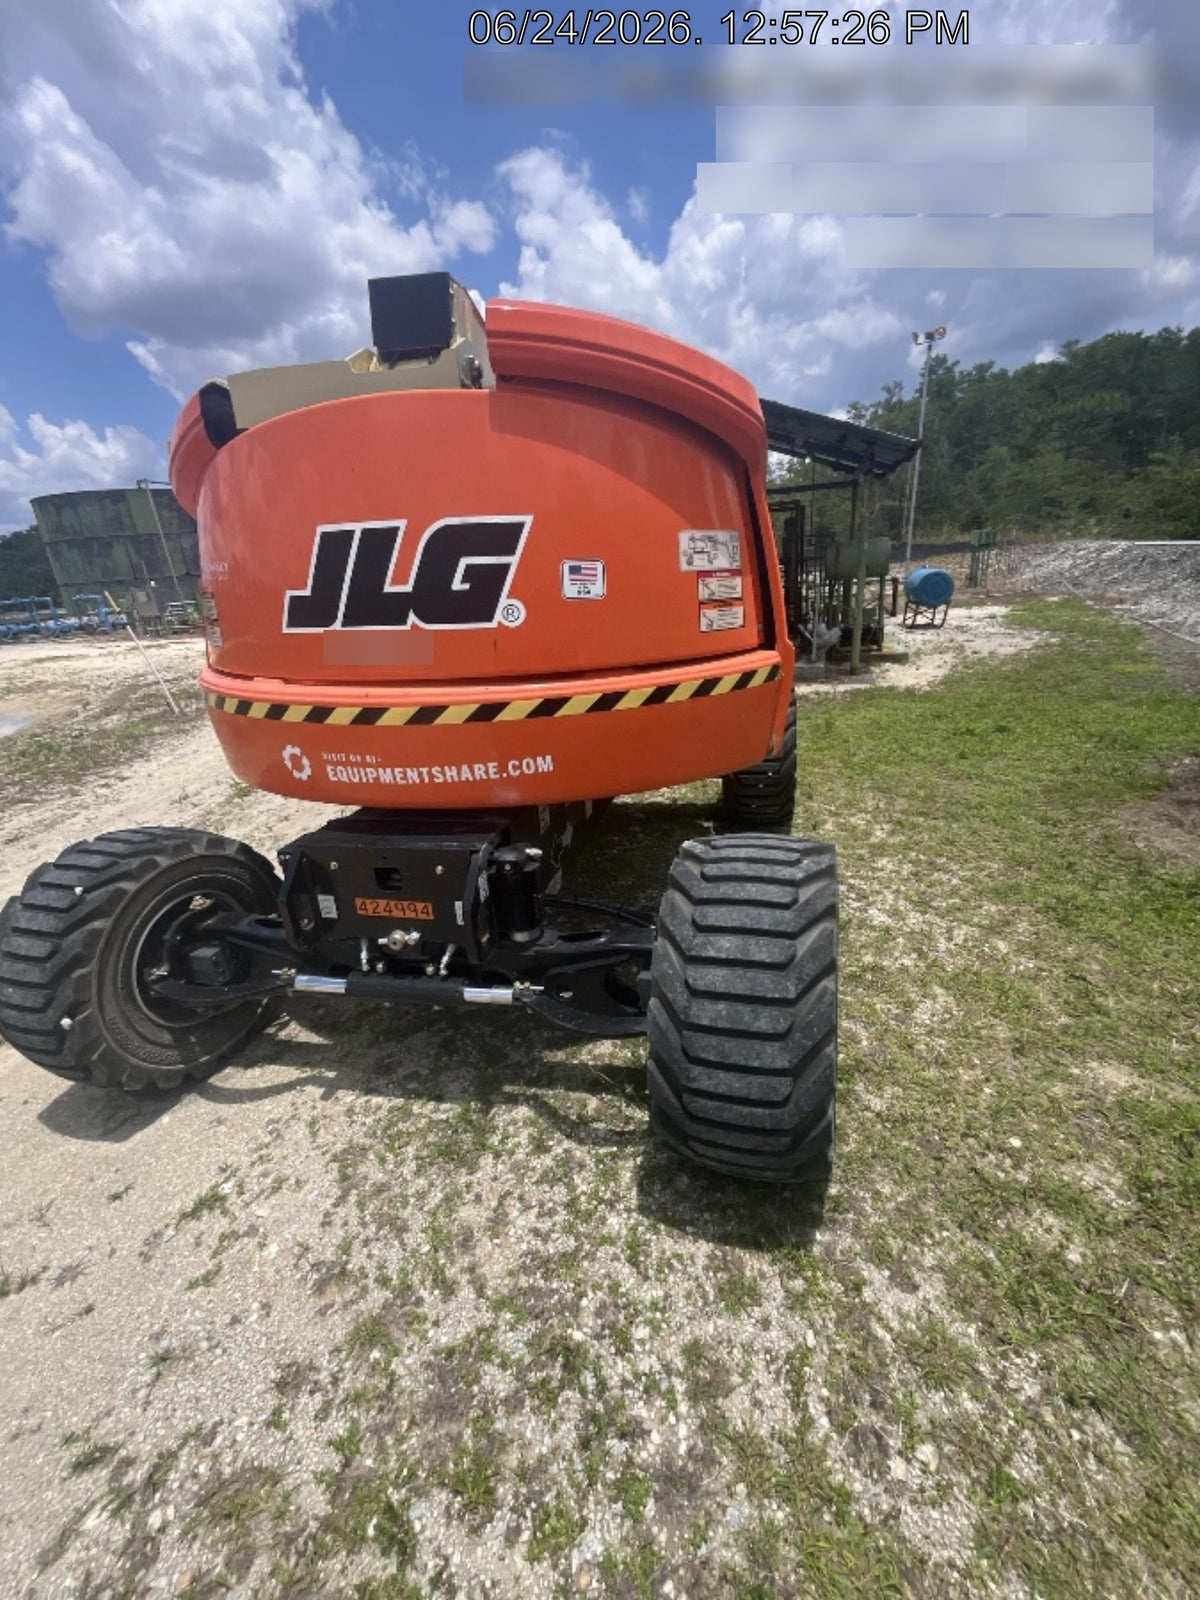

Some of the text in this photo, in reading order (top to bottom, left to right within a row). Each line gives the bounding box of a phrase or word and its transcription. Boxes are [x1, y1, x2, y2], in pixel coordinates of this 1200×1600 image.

[282, 515, 534, 633] JLG
[326, 755, 554, 785] EQUIPMENTSHARE.COM
[358, 899, 431, 918] 424994
